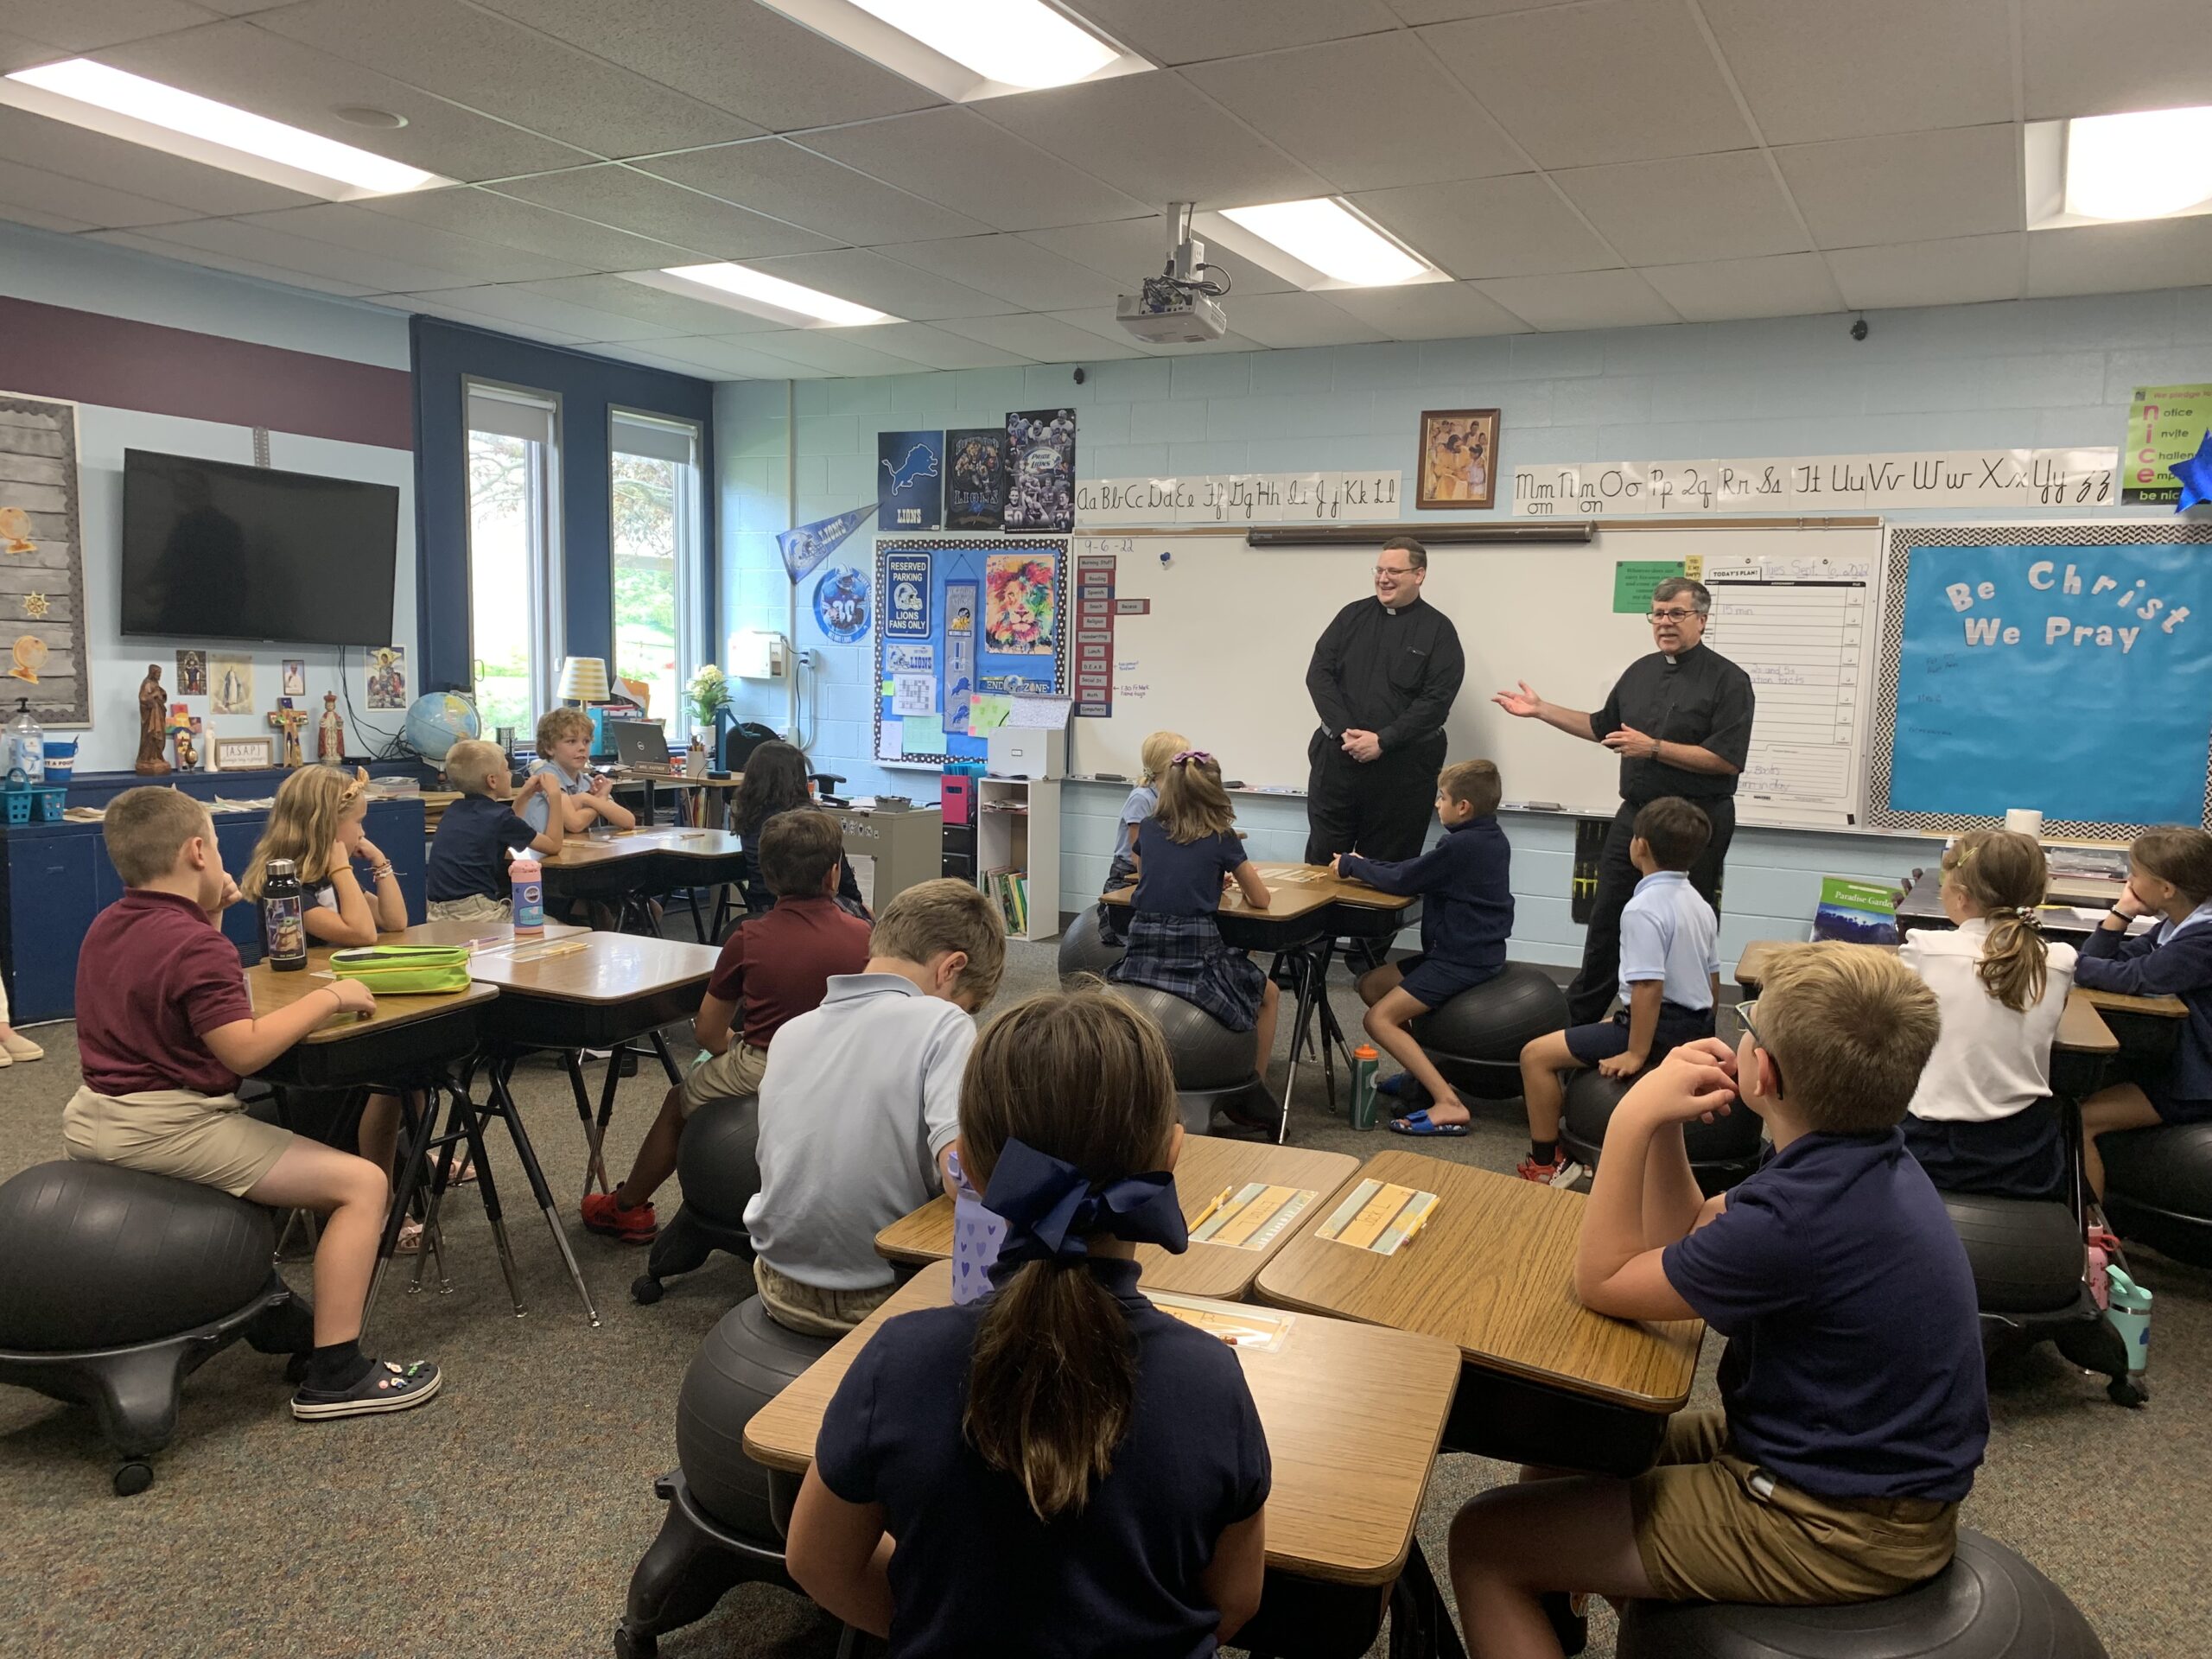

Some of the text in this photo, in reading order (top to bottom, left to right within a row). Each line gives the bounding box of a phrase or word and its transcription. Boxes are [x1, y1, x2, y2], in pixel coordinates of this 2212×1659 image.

[955, 490, 999, 505] LIONS
[2139, 490, 2180, 500] be nic
[897, 508, 922, 524] LIONS
[817, 518, 847, 545] LIONS
[890, 563, 926, 571] RESERVED
[893, 573, 923, 582] PARKING
[1945, 560, 2190, 634] Be Christ
[896, 611, 918, 620] LIONS
[889, 620, 926, 630] FANS ONLY
[1964, 616, 2141, 654] We Pray
[910, 657, 931, 669] LIONS
[987, 681, 1003, 690] END
[1835, 891, 1867, 904] Paradise
